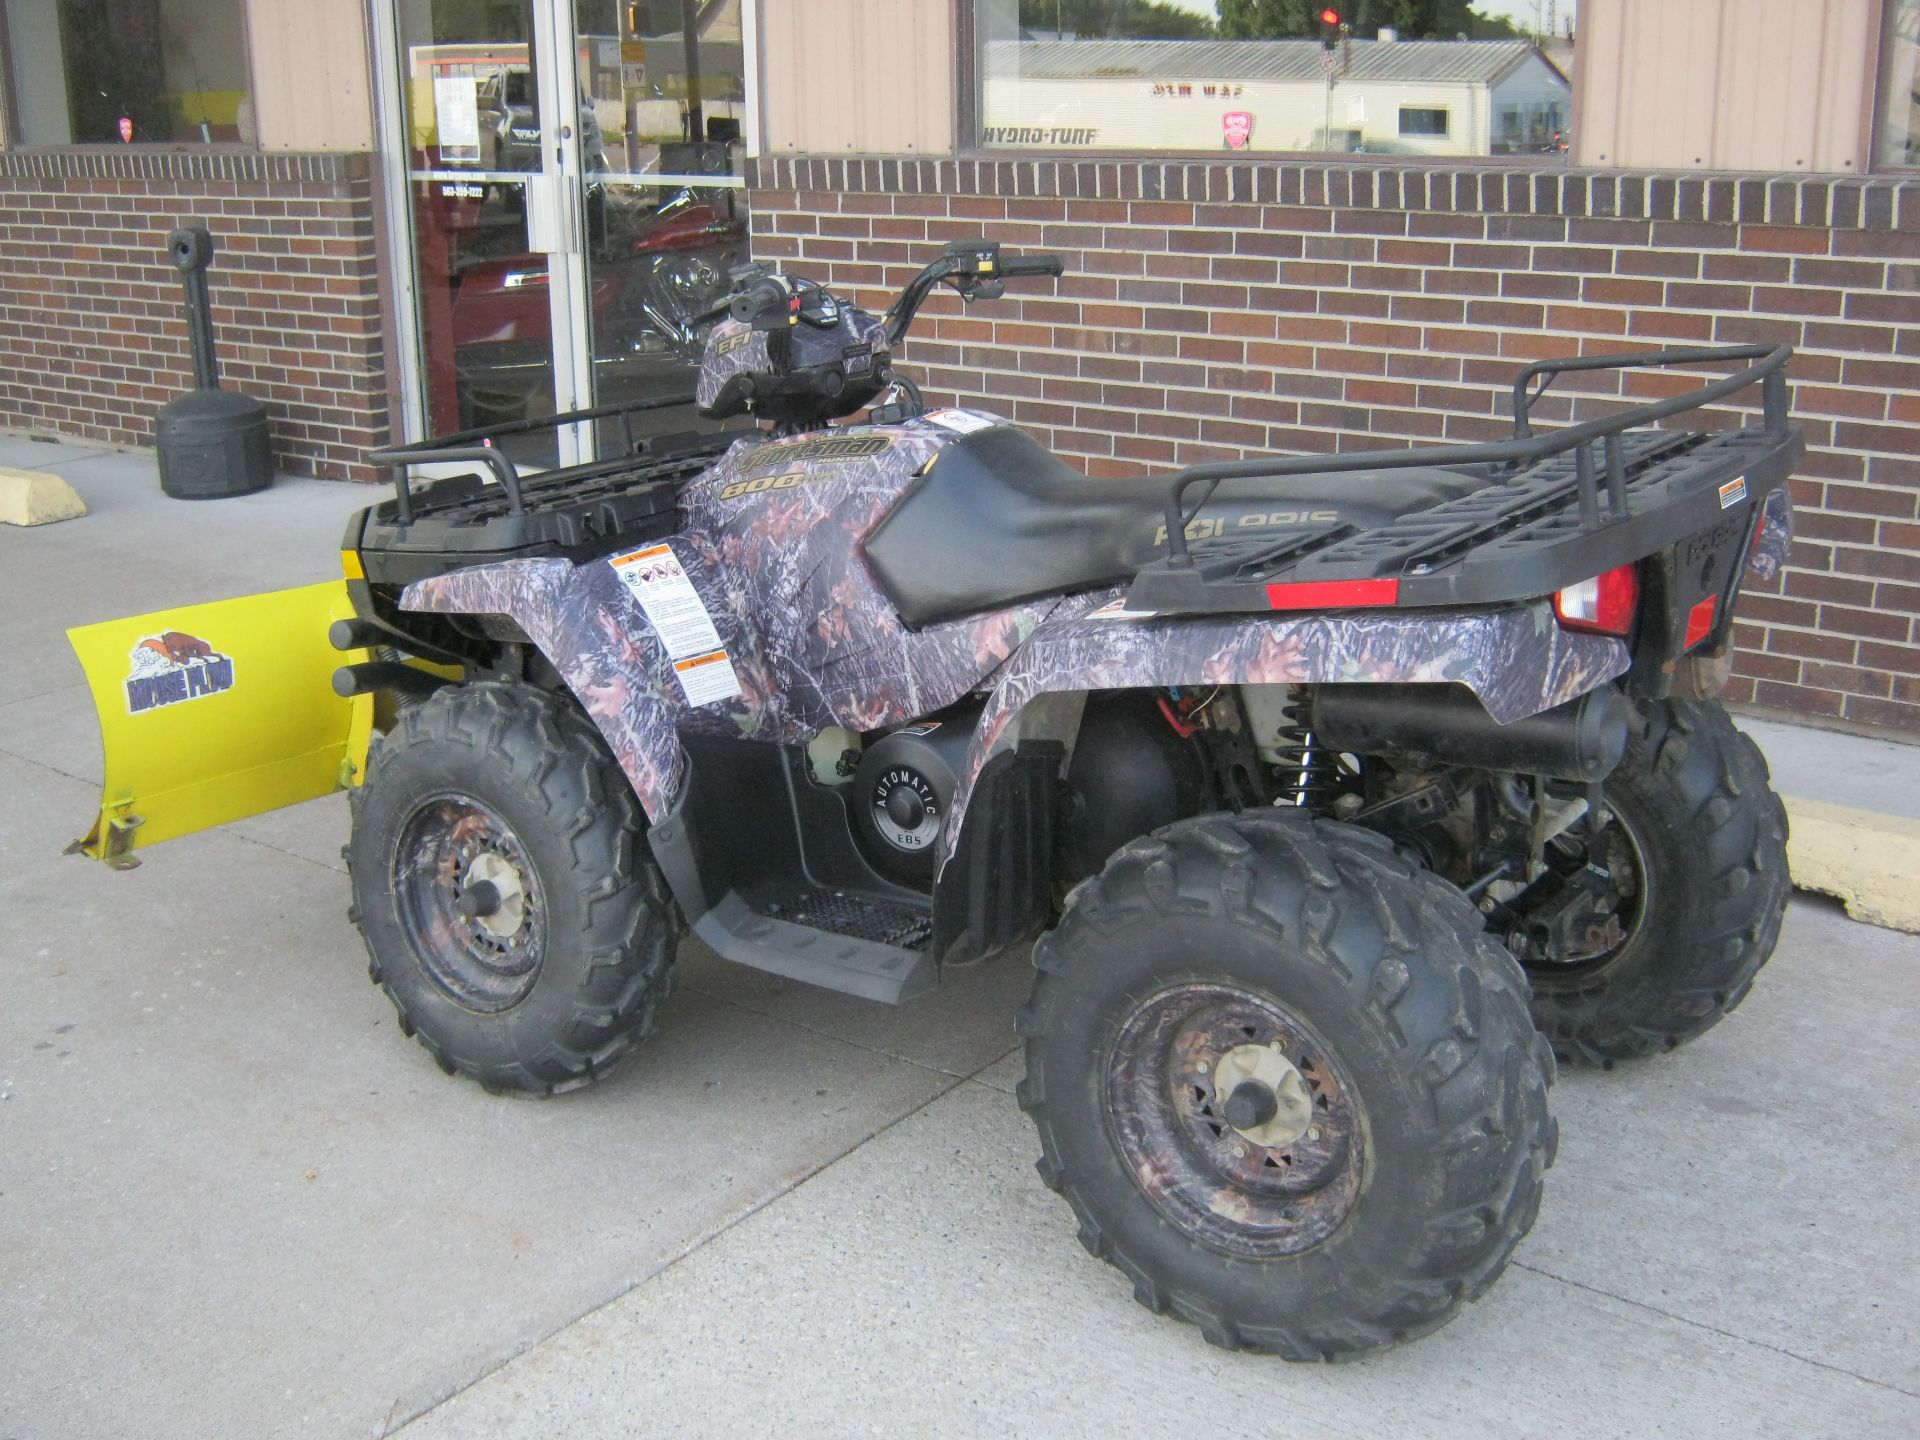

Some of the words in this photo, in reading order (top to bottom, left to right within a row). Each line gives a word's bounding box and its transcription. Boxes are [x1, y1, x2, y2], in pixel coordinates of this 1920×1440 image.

[983, 127, 1099, 144] HYDRO-TURF
[716, 332, 752, 358] EFI
[817, 456, 870, 464] HUNTER
[719, 473, 805, 501] 800
[126, 669, 188, 712] MOOSE
[186, 659, 234, 698] PLOW
[877, 770, 936, 814] AUTOMATIC
[897, 834, 922, 845] EBS
